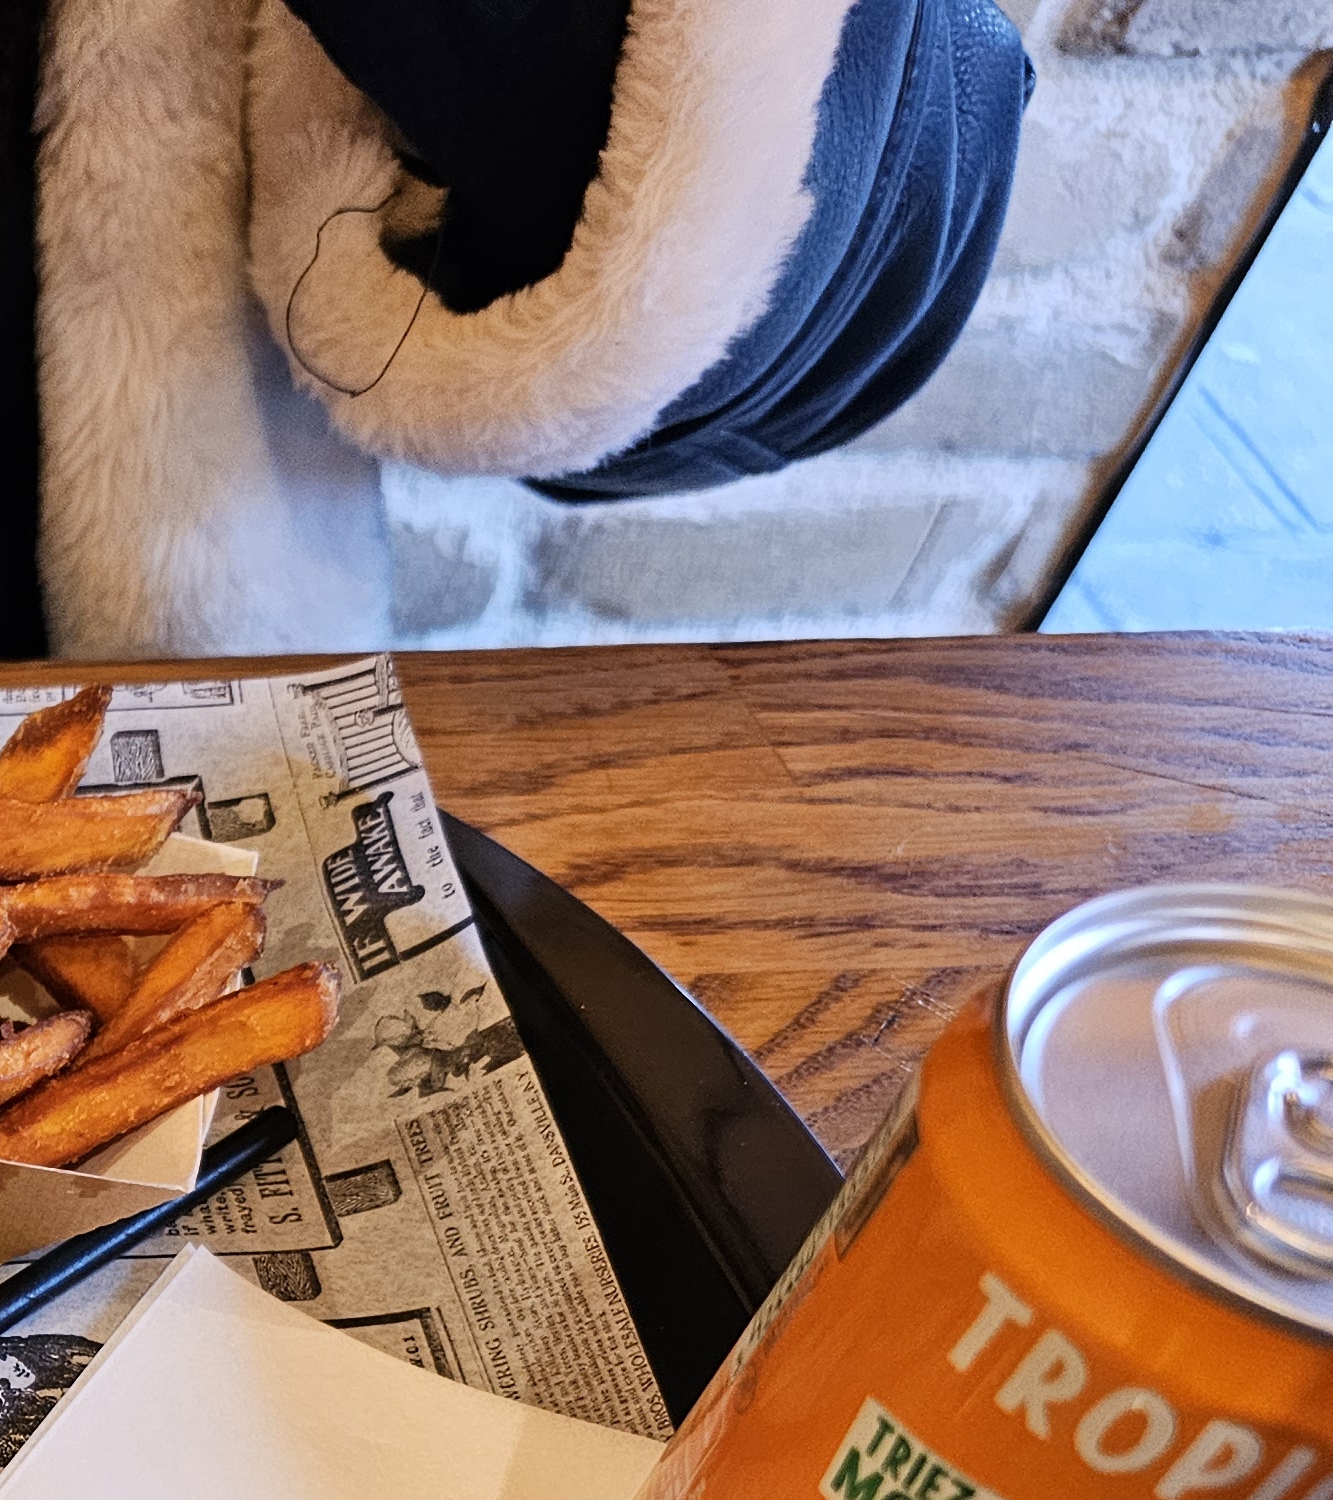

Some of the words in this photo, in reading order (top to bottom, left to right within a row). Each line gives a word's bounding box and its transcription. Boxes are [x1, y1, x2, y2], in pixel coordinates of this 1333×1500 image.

[353, 806, 407, 901] AWAKE
[421, 844, 444, 868] the
[323, 847, 372, 926] WIDE
[437, 881, 456, 899] to
[352, 930, 392, 971] IF
[403, 1117, 434, 1168] TREES
[422, 1169, 453, 1221] FRUIT
[441, 1224, 467, 1261] AND
[456, 1262, 494, 1333] SHRUBS,
[610, 1302, 655, 1392] WHOLESALE
